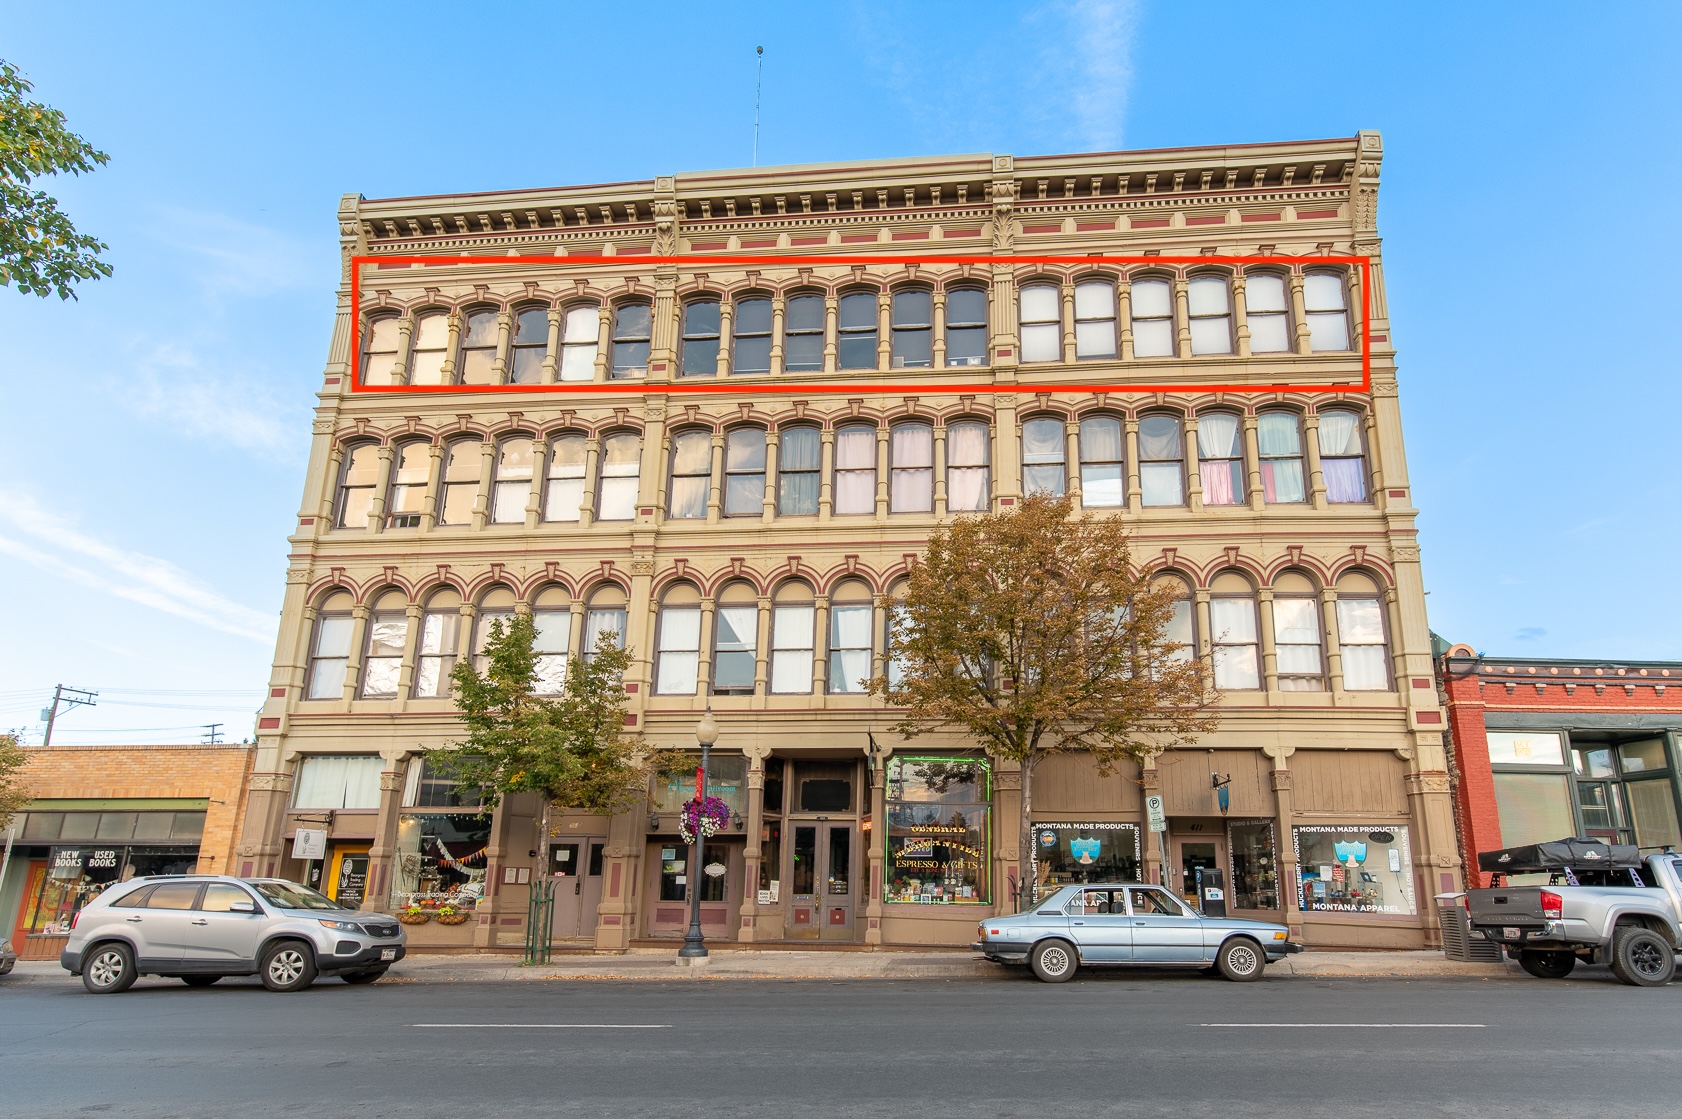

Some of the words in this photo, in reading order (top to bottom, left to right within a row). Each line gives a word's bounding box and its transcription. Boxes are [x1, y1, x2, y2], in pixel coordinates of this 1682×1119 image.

[910, 824, 966, 833] GENERAL
[1400, 829, 1410, 865] SOUVENIRS
[60, 850, 80, 859] NEW
[94, 850, 116, 859] USED
[54, 858, 82, 867] BOOKS
[88, 858, 117, 867] BOOKS
[895, 860, 939, 868] ESPRESSO
[950, 860, 978, 869] GIFTS
[1405, 872, 1413, 885] HOT
[1296, 862, 1304, 908] HUCKLEBERRY
[1407, 886, 1415, 910] SAUCE
[1312, 902, 1358, 912] MONTANA
[1360, 904, 1400, 912] APPAREL
